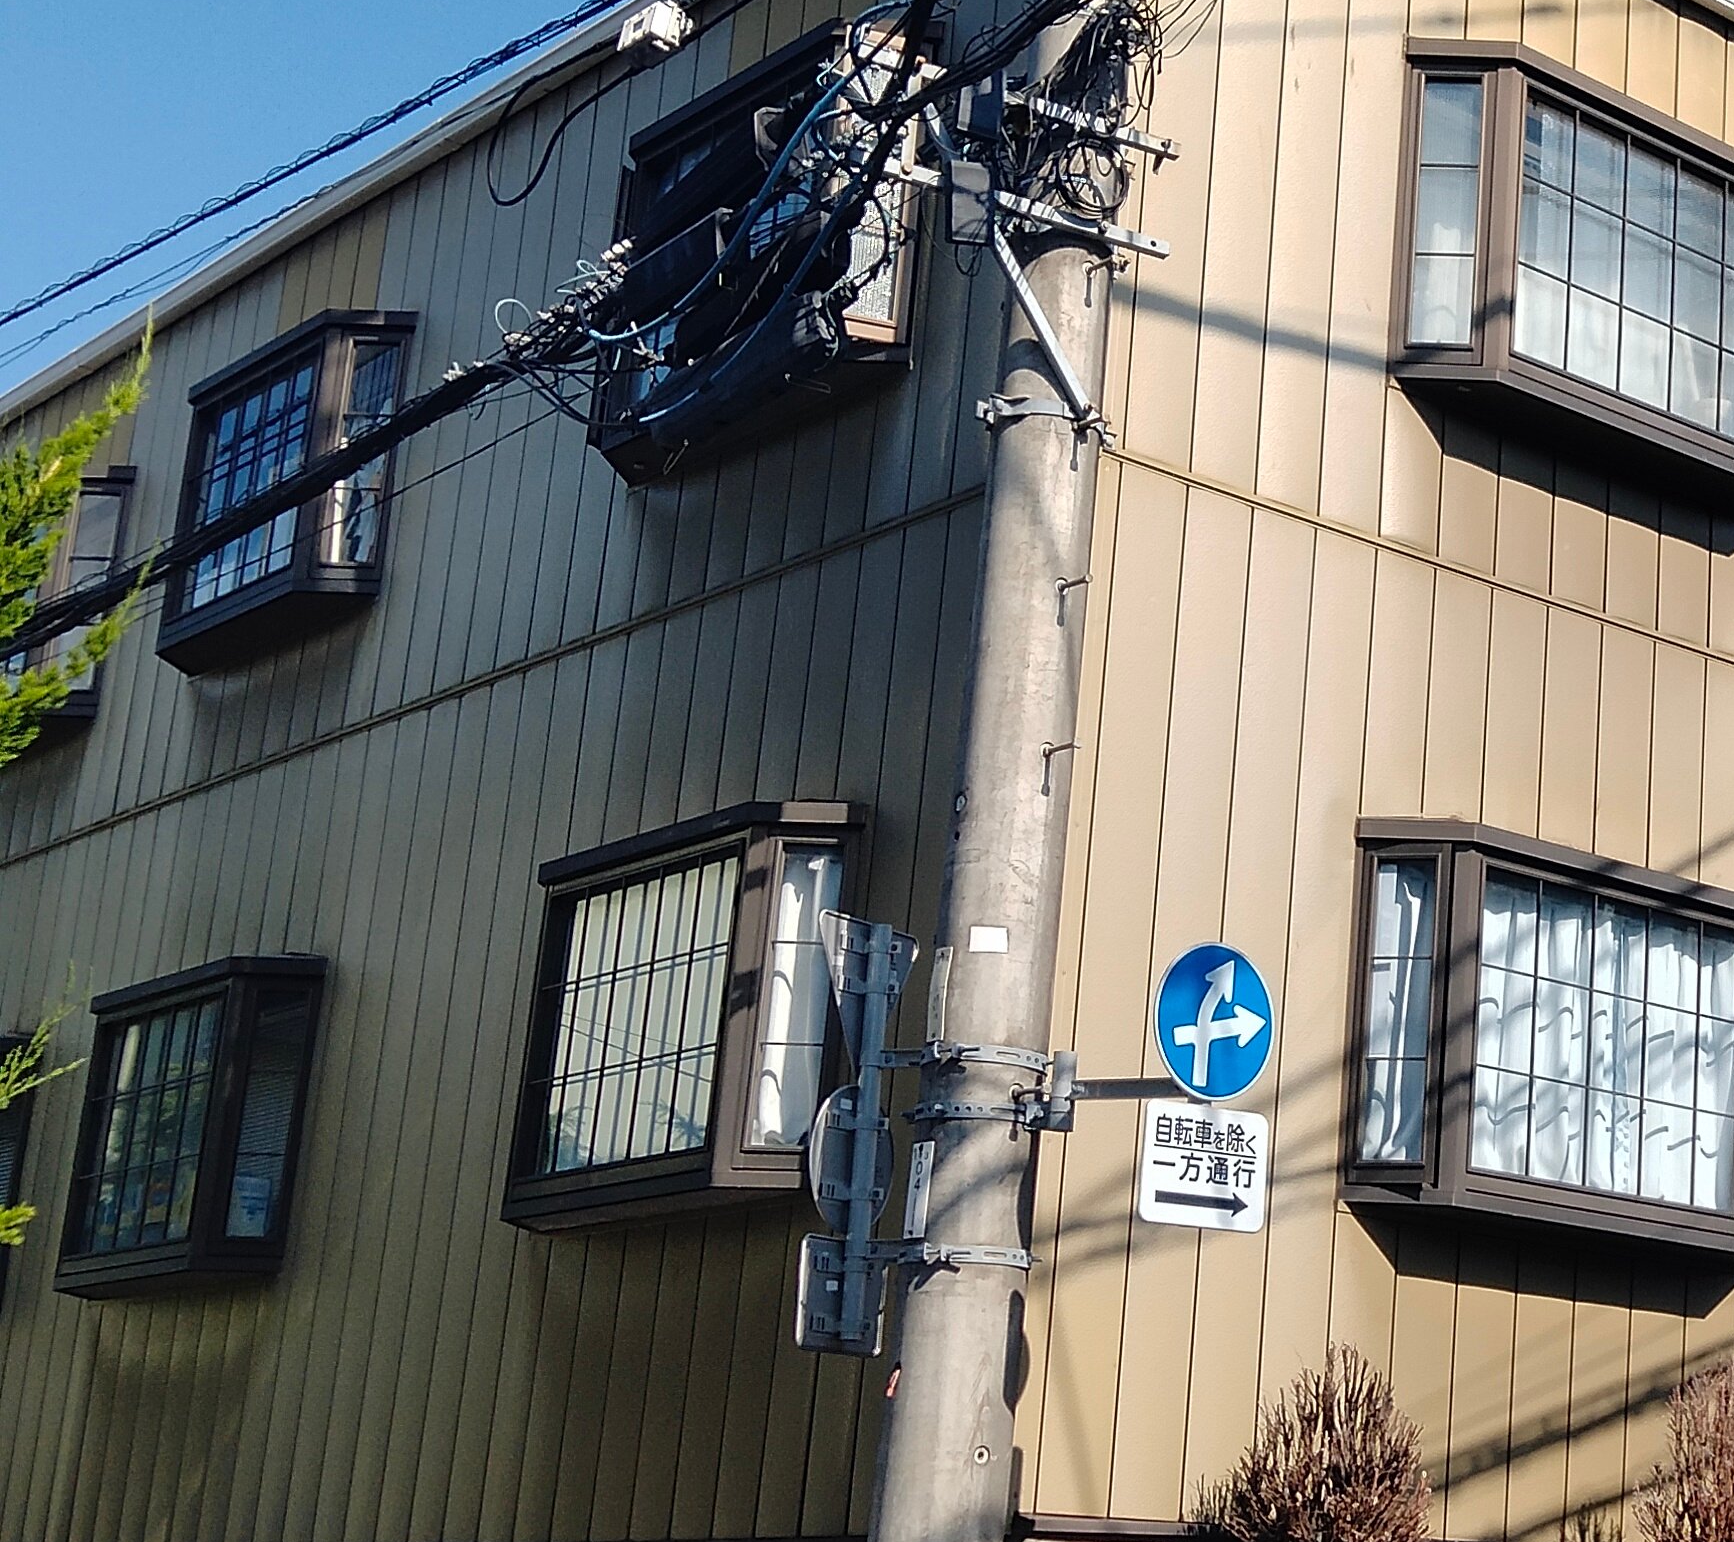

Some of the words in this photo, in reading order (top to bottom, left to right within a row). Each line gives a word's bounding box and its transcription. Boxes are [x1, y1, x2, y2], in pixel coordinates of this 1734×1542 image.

[1155, 1113, 1256, 1155] 自転車を除く
[1152, 1152, 1256, 1188] 一方通行
